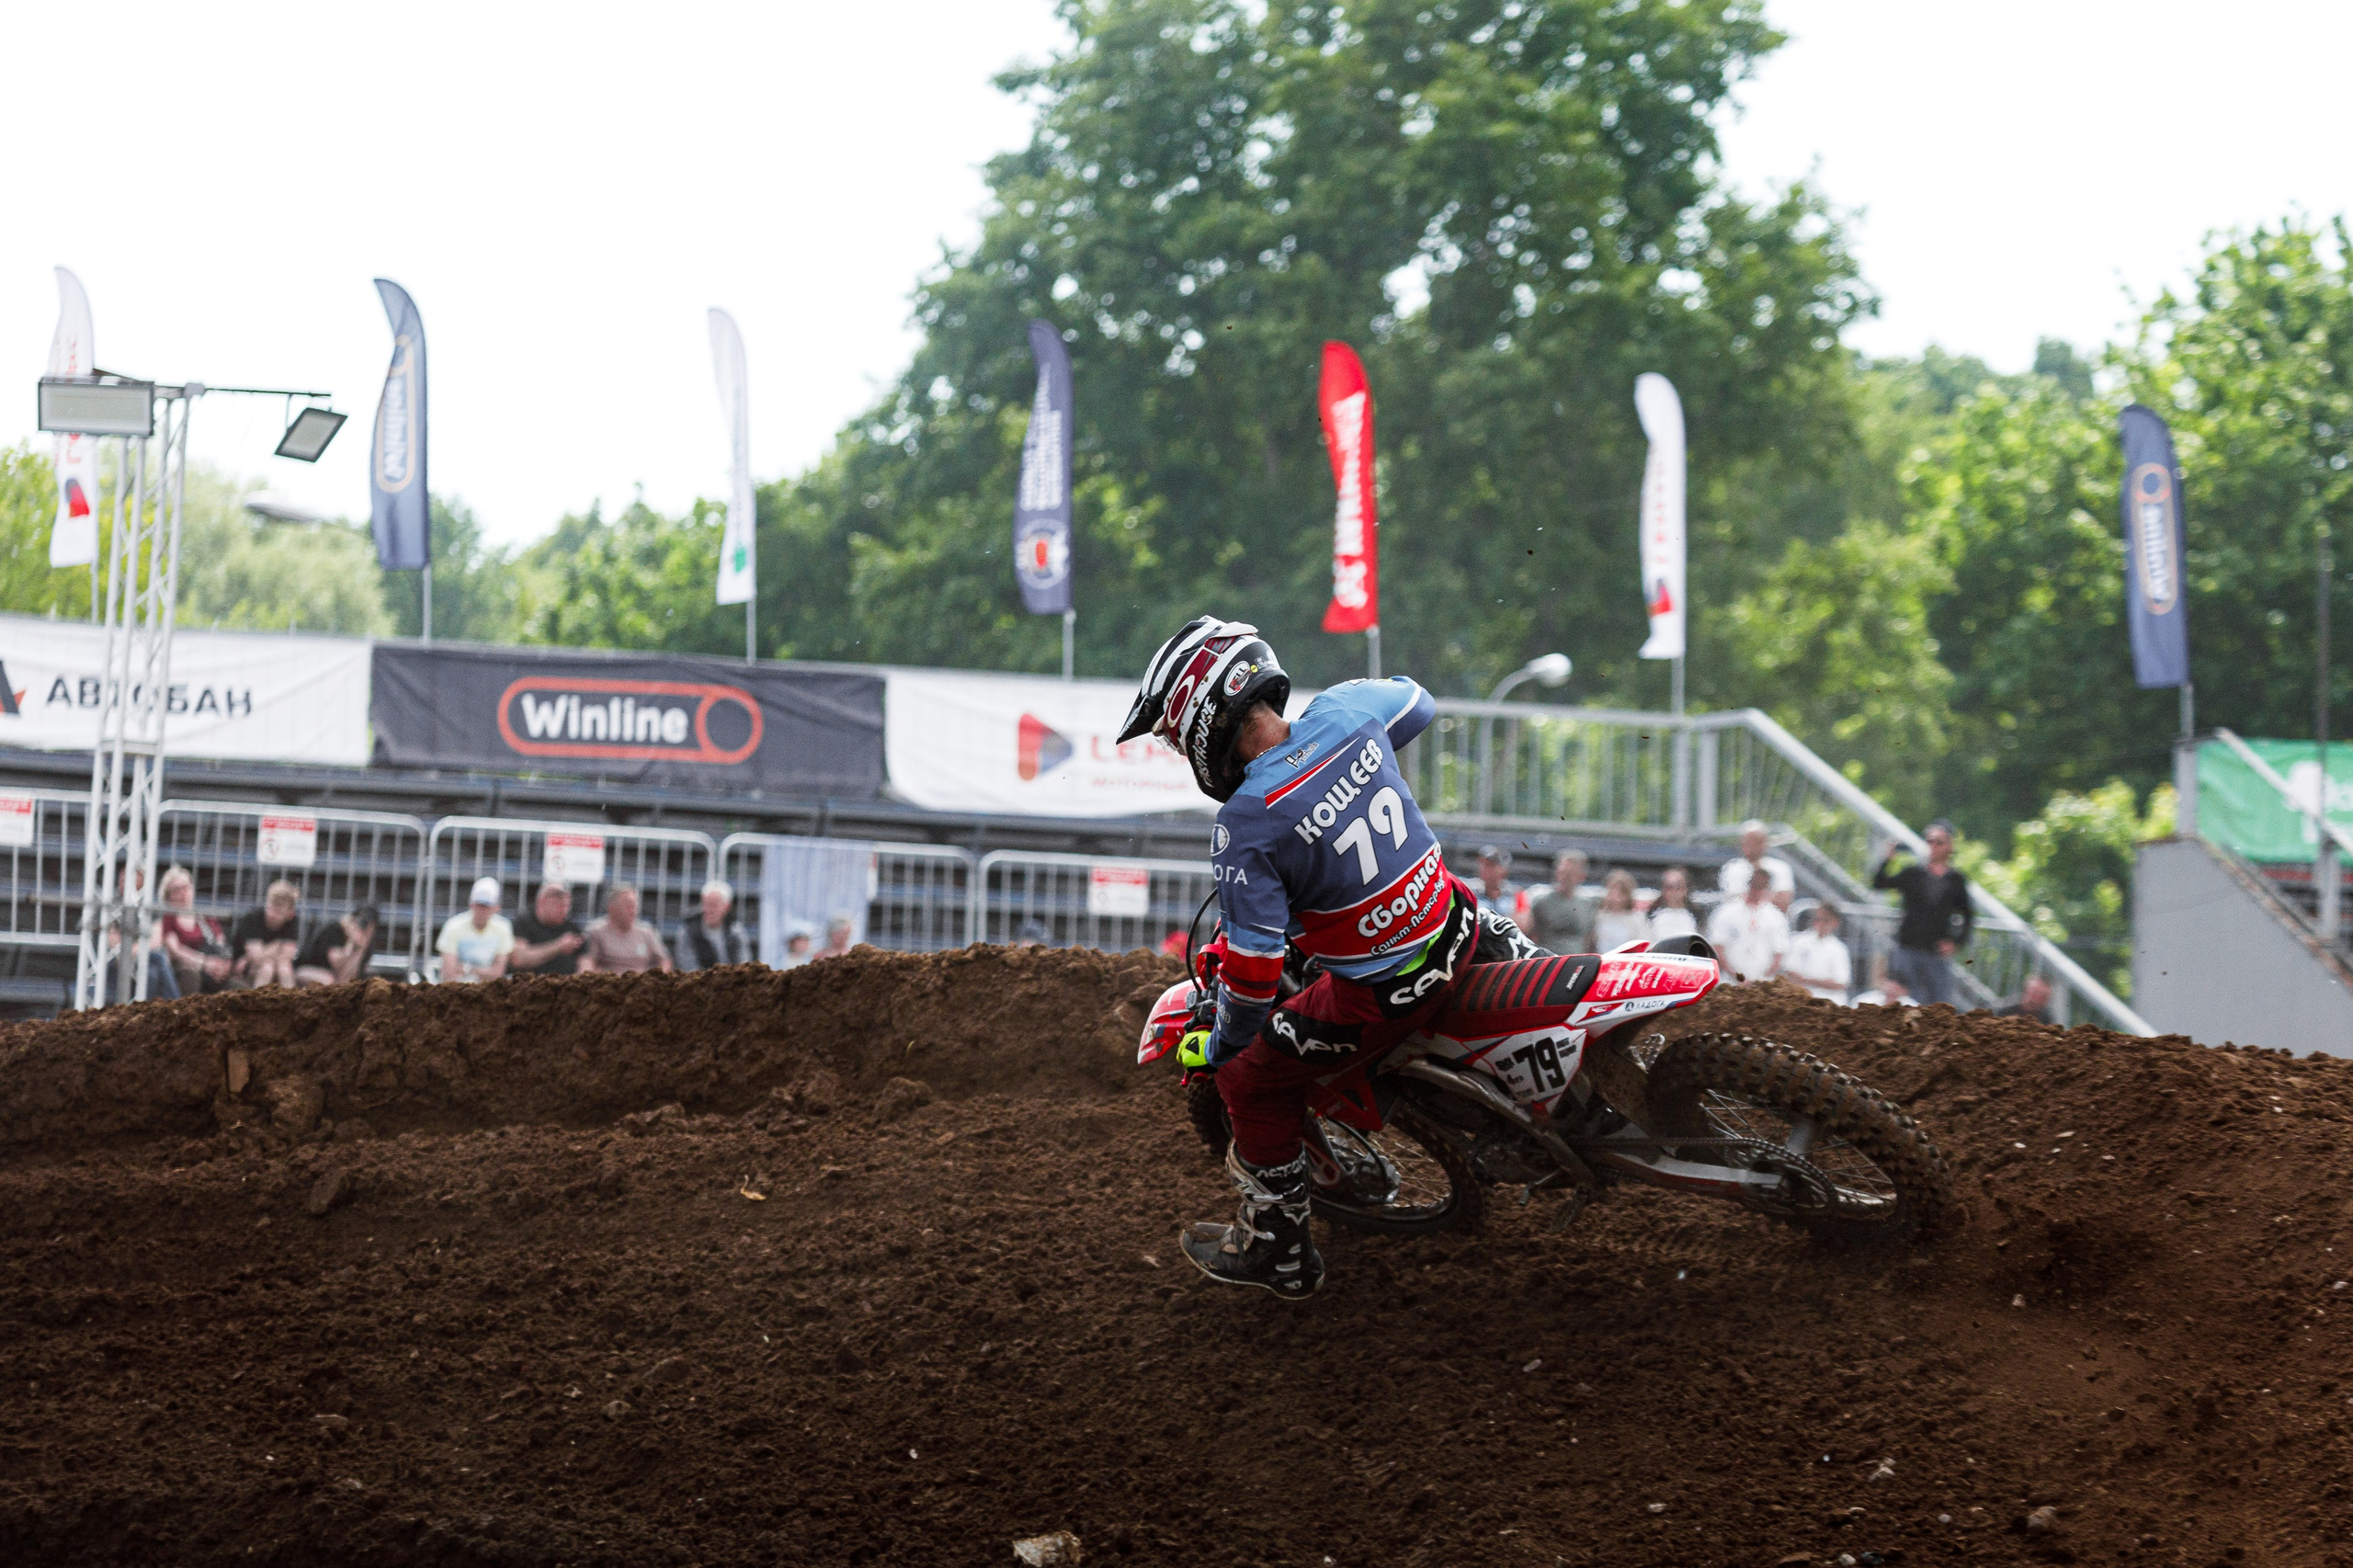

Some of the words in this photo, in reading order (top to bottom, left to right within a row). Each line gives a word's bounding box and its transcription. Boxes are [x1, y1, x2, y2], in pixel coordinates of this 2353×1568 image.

[520, 694, 689, 744] Winline
[1294, 737, 1384, 846] КОЩЕЕВ
[1332, 786, 1409, 886] 79
[1513, 1037, 1567, 1094] 79
